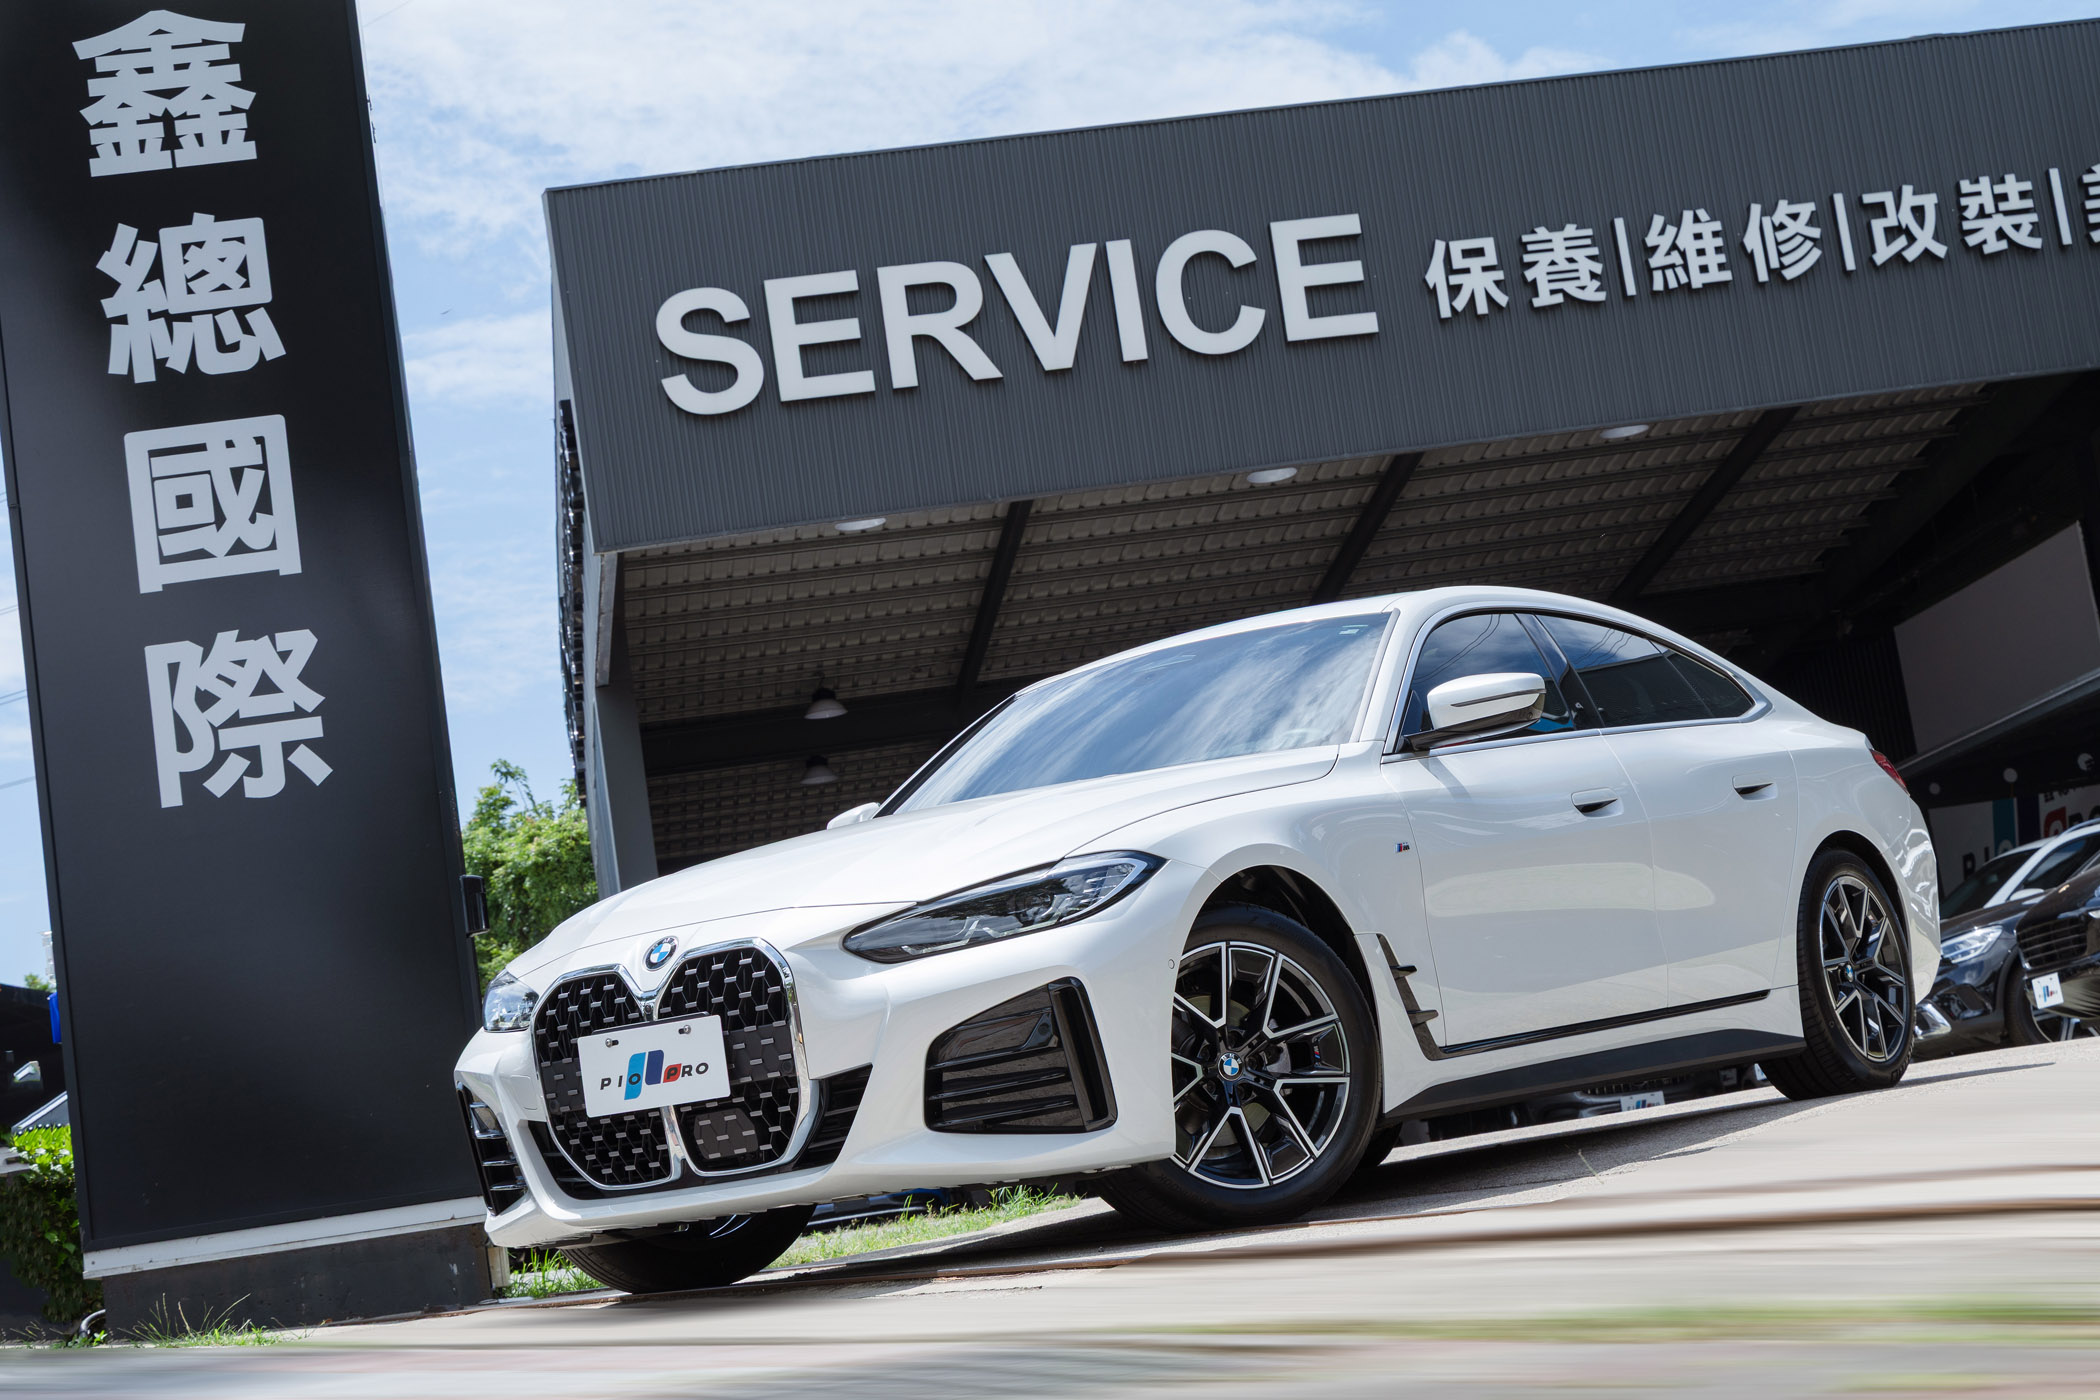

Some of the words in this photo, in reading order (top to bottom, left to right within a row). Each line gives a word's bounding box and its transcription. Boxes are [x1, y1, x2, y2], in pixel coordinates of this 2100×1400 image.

[72, 9, 334, 809] 鑫總國際
[655, 213, 1380, 416] SERVICE
[599, 1072, 641, 1091] PIO
[666, 1062, 709, 1080] PRO
